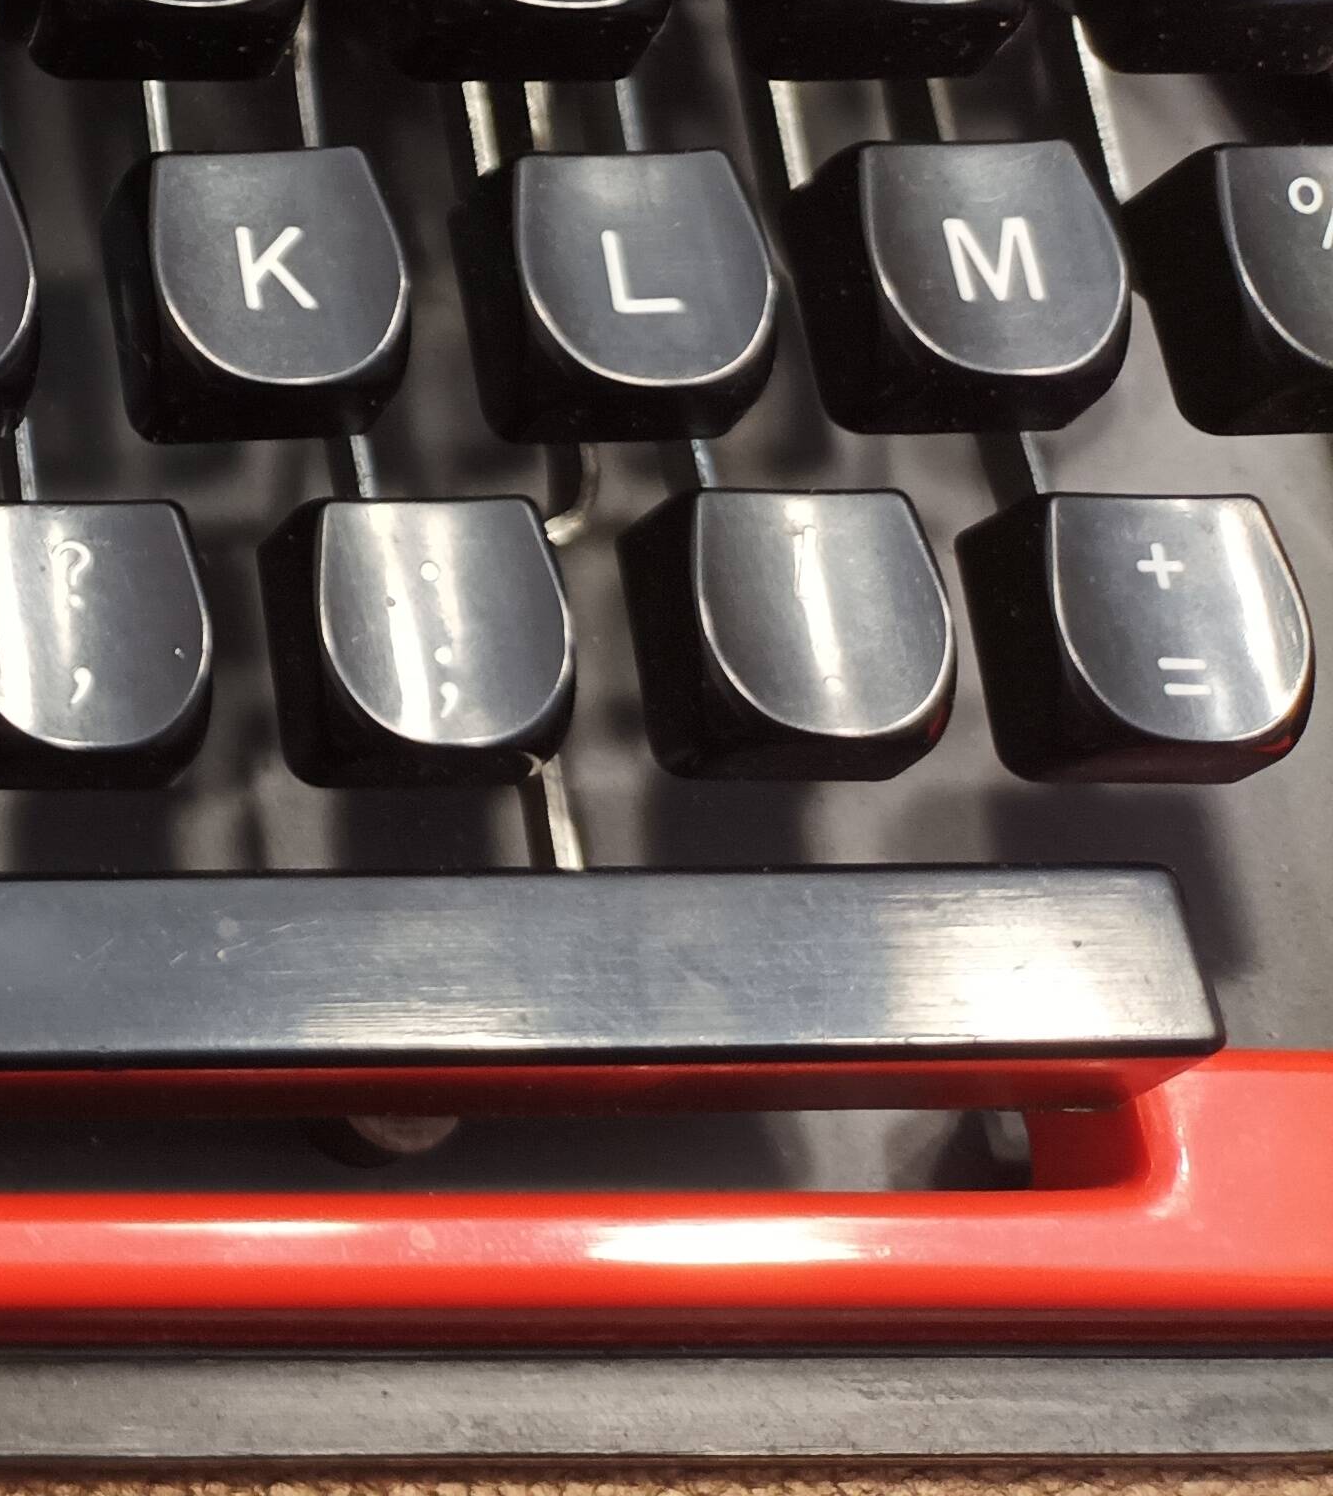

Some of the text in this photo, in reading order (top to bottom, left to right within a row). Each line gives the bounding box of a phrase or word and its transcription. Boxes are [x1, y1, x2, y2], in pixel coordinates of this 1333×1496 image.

[234, 225, 318, 312] K
[600, 229, 685, 315] L
[941, 215, 1048, 303] M
[50, 539, 93, 608] ?
[1136, 542, 1186, 591] +
[69, 666, 93, 705] ,
[1157, 657, 1214, 697] =
